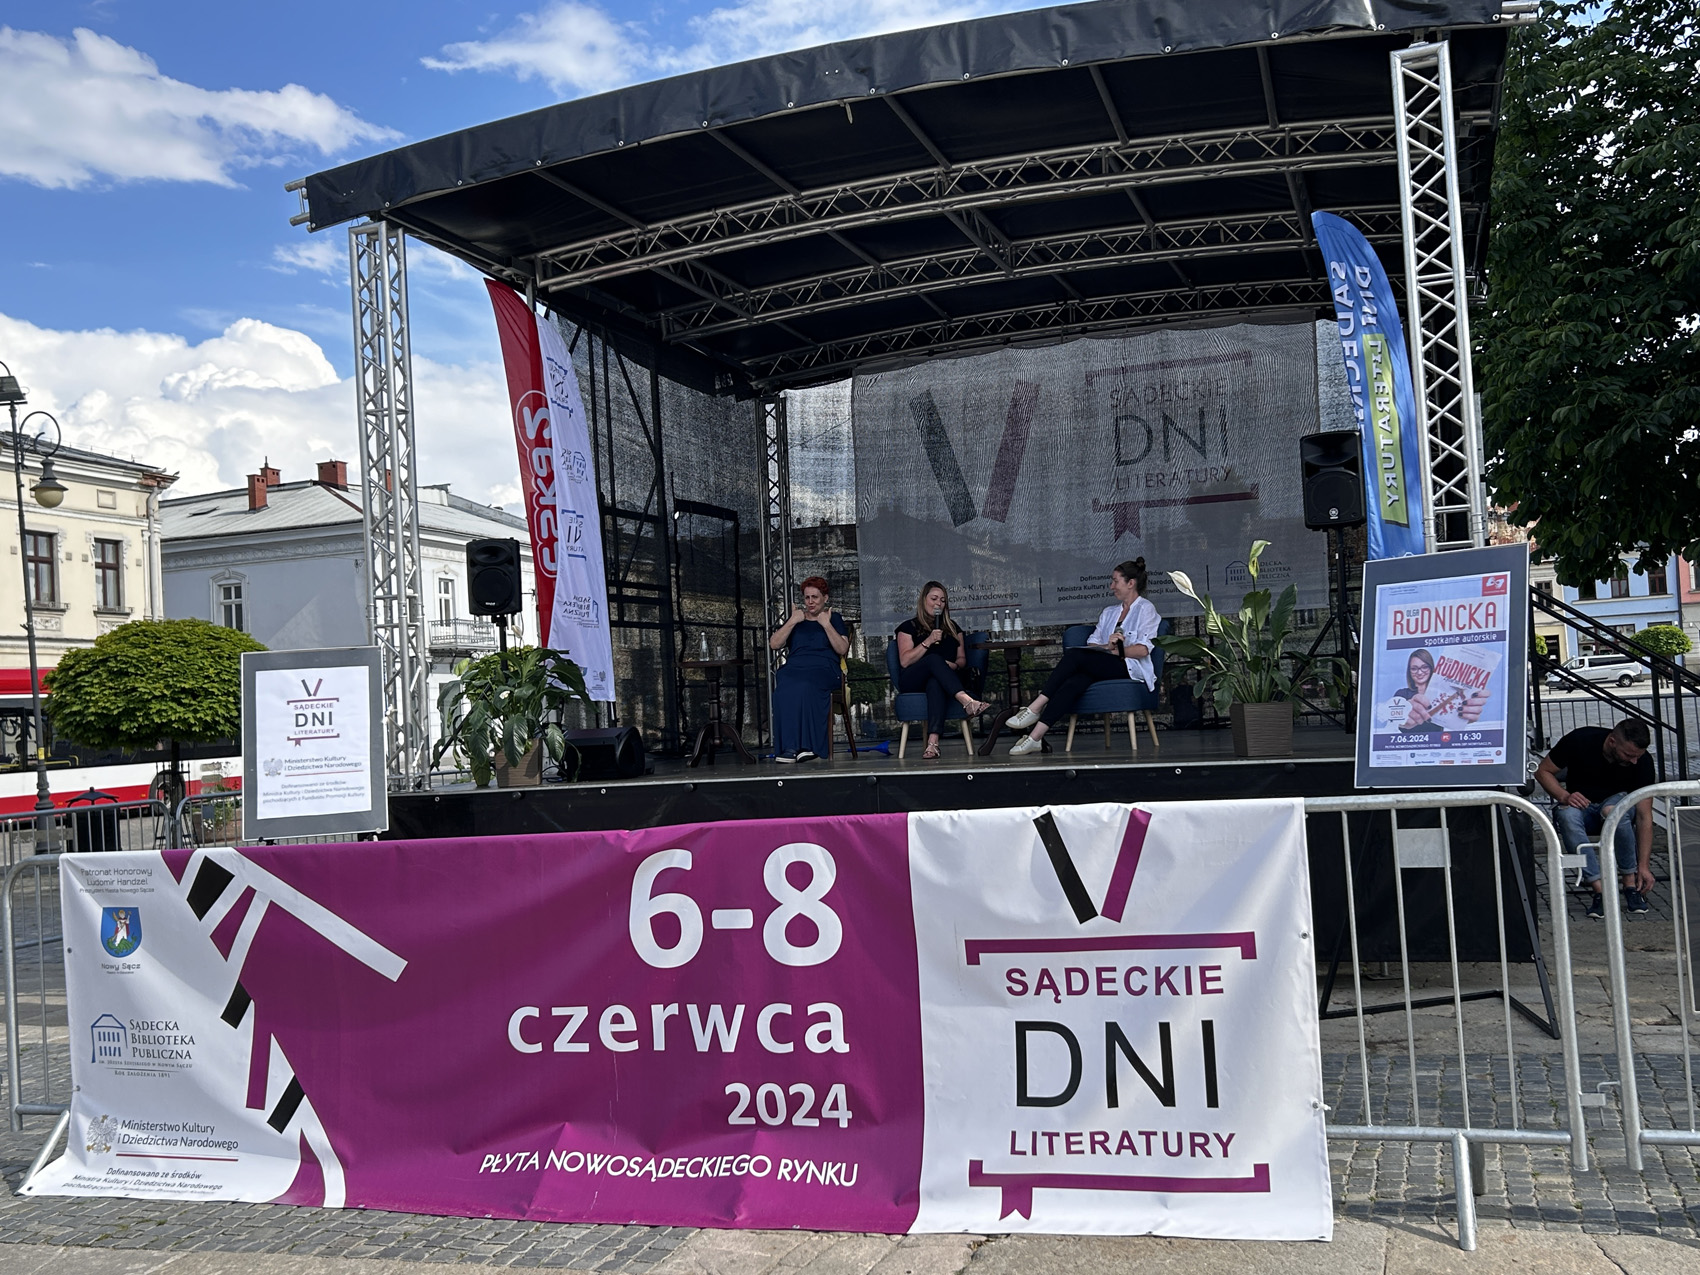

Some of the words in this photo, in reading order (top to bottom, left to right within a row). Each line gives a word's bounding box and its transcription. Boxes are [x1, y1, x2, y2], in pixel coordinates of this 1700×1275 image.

[1114, 404, 1228, 467] DNI
[1116, 466, 1232, 490] LITERATURY
[969, 591, 1018, 600] Narodowego
[1406, 609, 1419, 617] OLGA
[1424, 636, 1460, 646] spotkanie
[1462, 632, 1497, 642] autorskie
[1434, 656, 1491, 690] RUDNICKA
[295, 711, 332, 727] DNI
[1390, 734, 1429, 743] 7.06.2024
[114, 868, 152, 876] Honorowy
[630, 842, 843, 968] 6-8
[1005, 964, 1224, 1004] SĄDECKIE
[130, 1019, 180, 1032] SĄDECKA
[508, 1002, 850, 1054] czerwca
[131, 1033, 195, 1045] BIBLIOTEKA
[132, 1047, 192, 1060] PUBLICZNA
[1015, 1020, 1219, 1108] DNI
[724, 1082, 852, 1128] 2024
[121, 1120, 180, 1132] Ministerstwo
[182, 1122, 215, 1135] Kultury
[122, 1134, 178, 1147] Dziedzictwa
[180, 1137, 239, 1151] Narodowego
[1010, 1130, 1236, 1158] LITERATURY
[106, 1168, 160, 1178] Dofinansowano
[171, 1170, 202, 1179] środków
[479, 1150, 540, 1174] PŁYTA
[544, 1149, 772, 1182] NOWOSĄDECKIEGO
[777, 1158, 858, 1186] RYNKU
[177, 1182, 223, 1190] Narodowego
